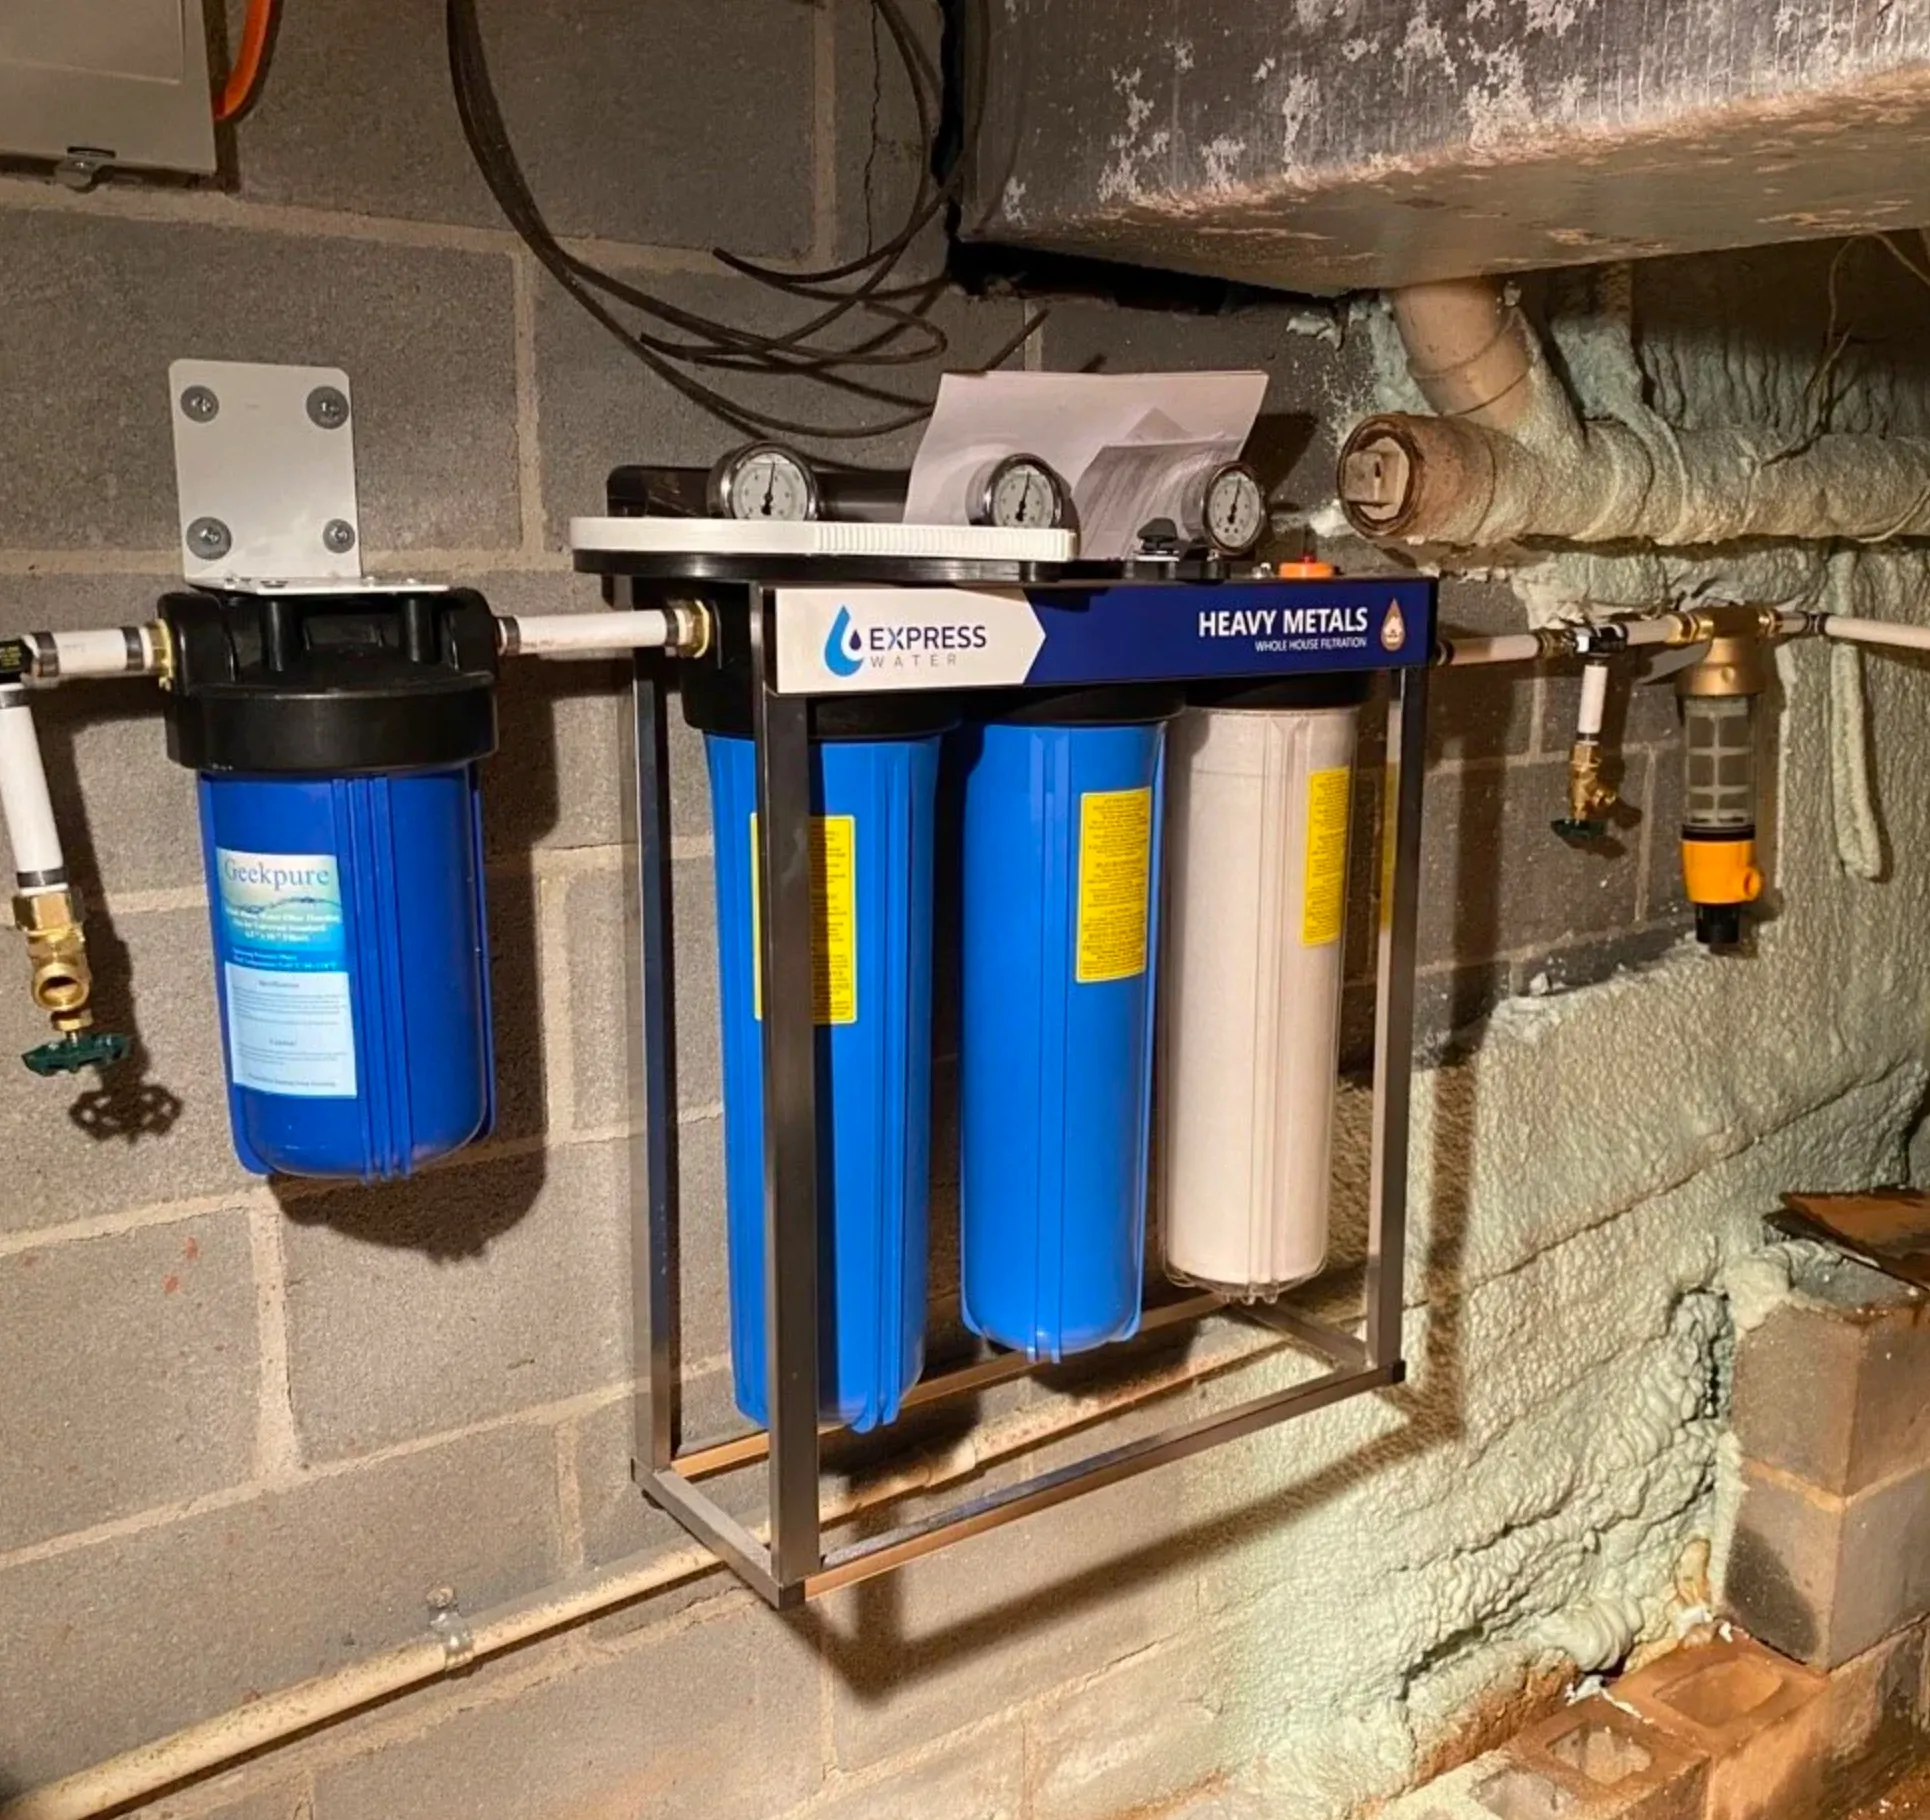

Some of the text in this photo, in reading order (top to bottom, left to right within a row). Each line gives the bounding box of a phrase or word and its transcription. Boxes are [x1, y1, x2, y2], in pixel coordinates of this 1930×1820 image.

[1199, 607, 1368, 637] HEAVY METALS
[870, 625, 987, 650] EXPRESS
[1254, 636, 1367, 652] WHOLE HOUSE FILTRATION
[870, 653, 957, 668] WATER
[224, 858, 330, 892] Geekpure
